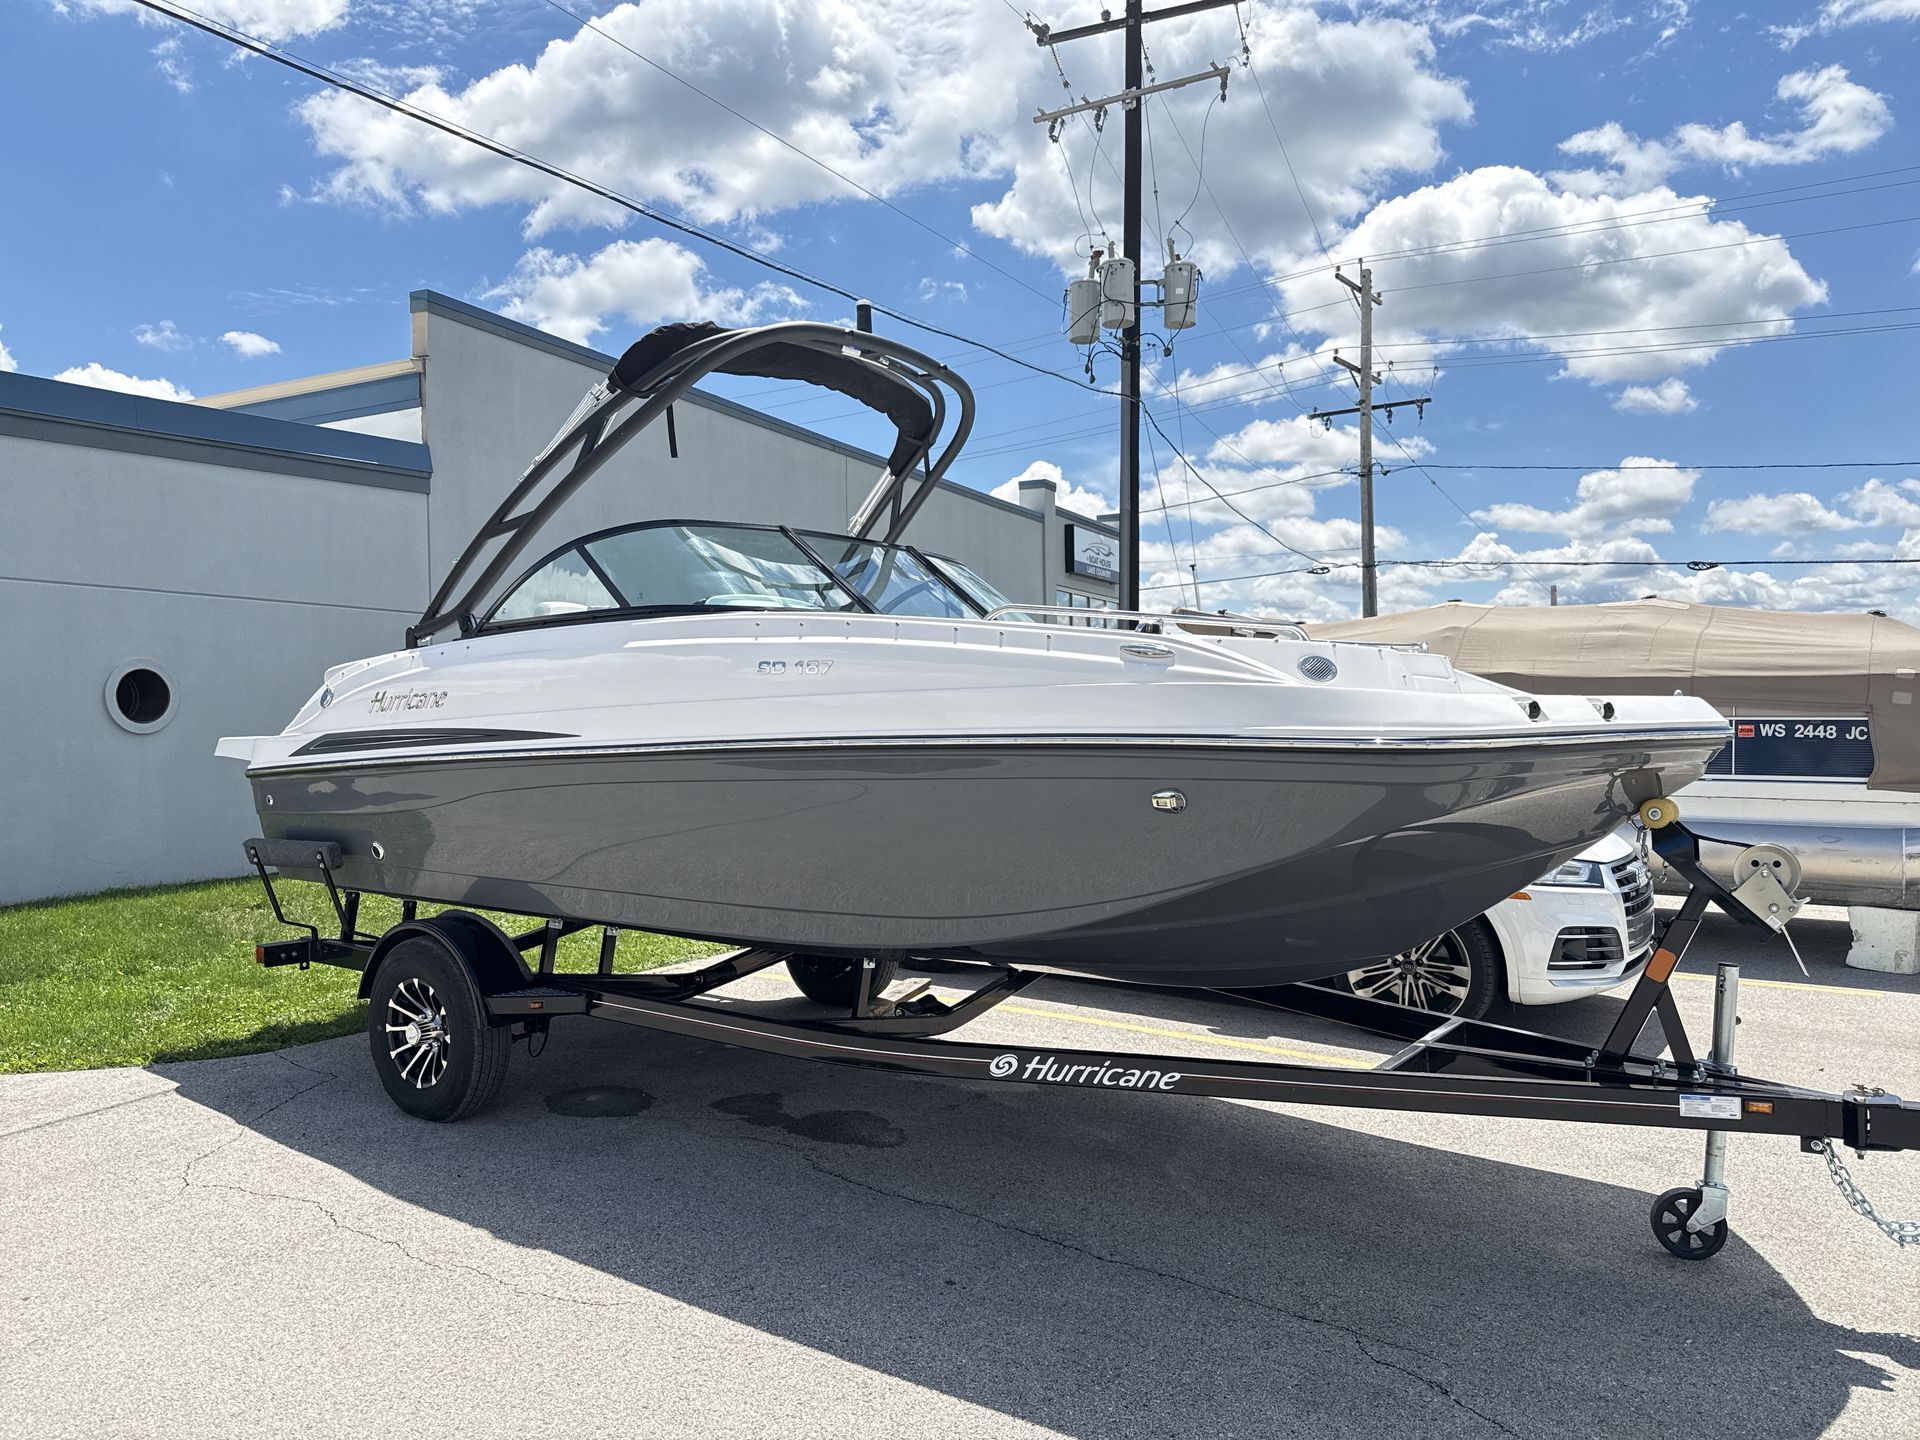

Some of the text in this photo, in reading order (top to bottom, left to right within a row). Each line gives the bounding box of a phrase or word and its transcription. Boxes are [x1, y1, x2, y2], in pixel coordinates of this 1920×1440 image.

[1089, 555, 1098, 565] BOAT
[1099, 558, 1111, 568] HOUSE
[757, 659, 834, 675] SD 187
[368, 688, 448, 714] Hurricane
[1759, 723, 1868, 741] WS 2448 JC
[1021, 1055, 1181, 1090] Hurricane
